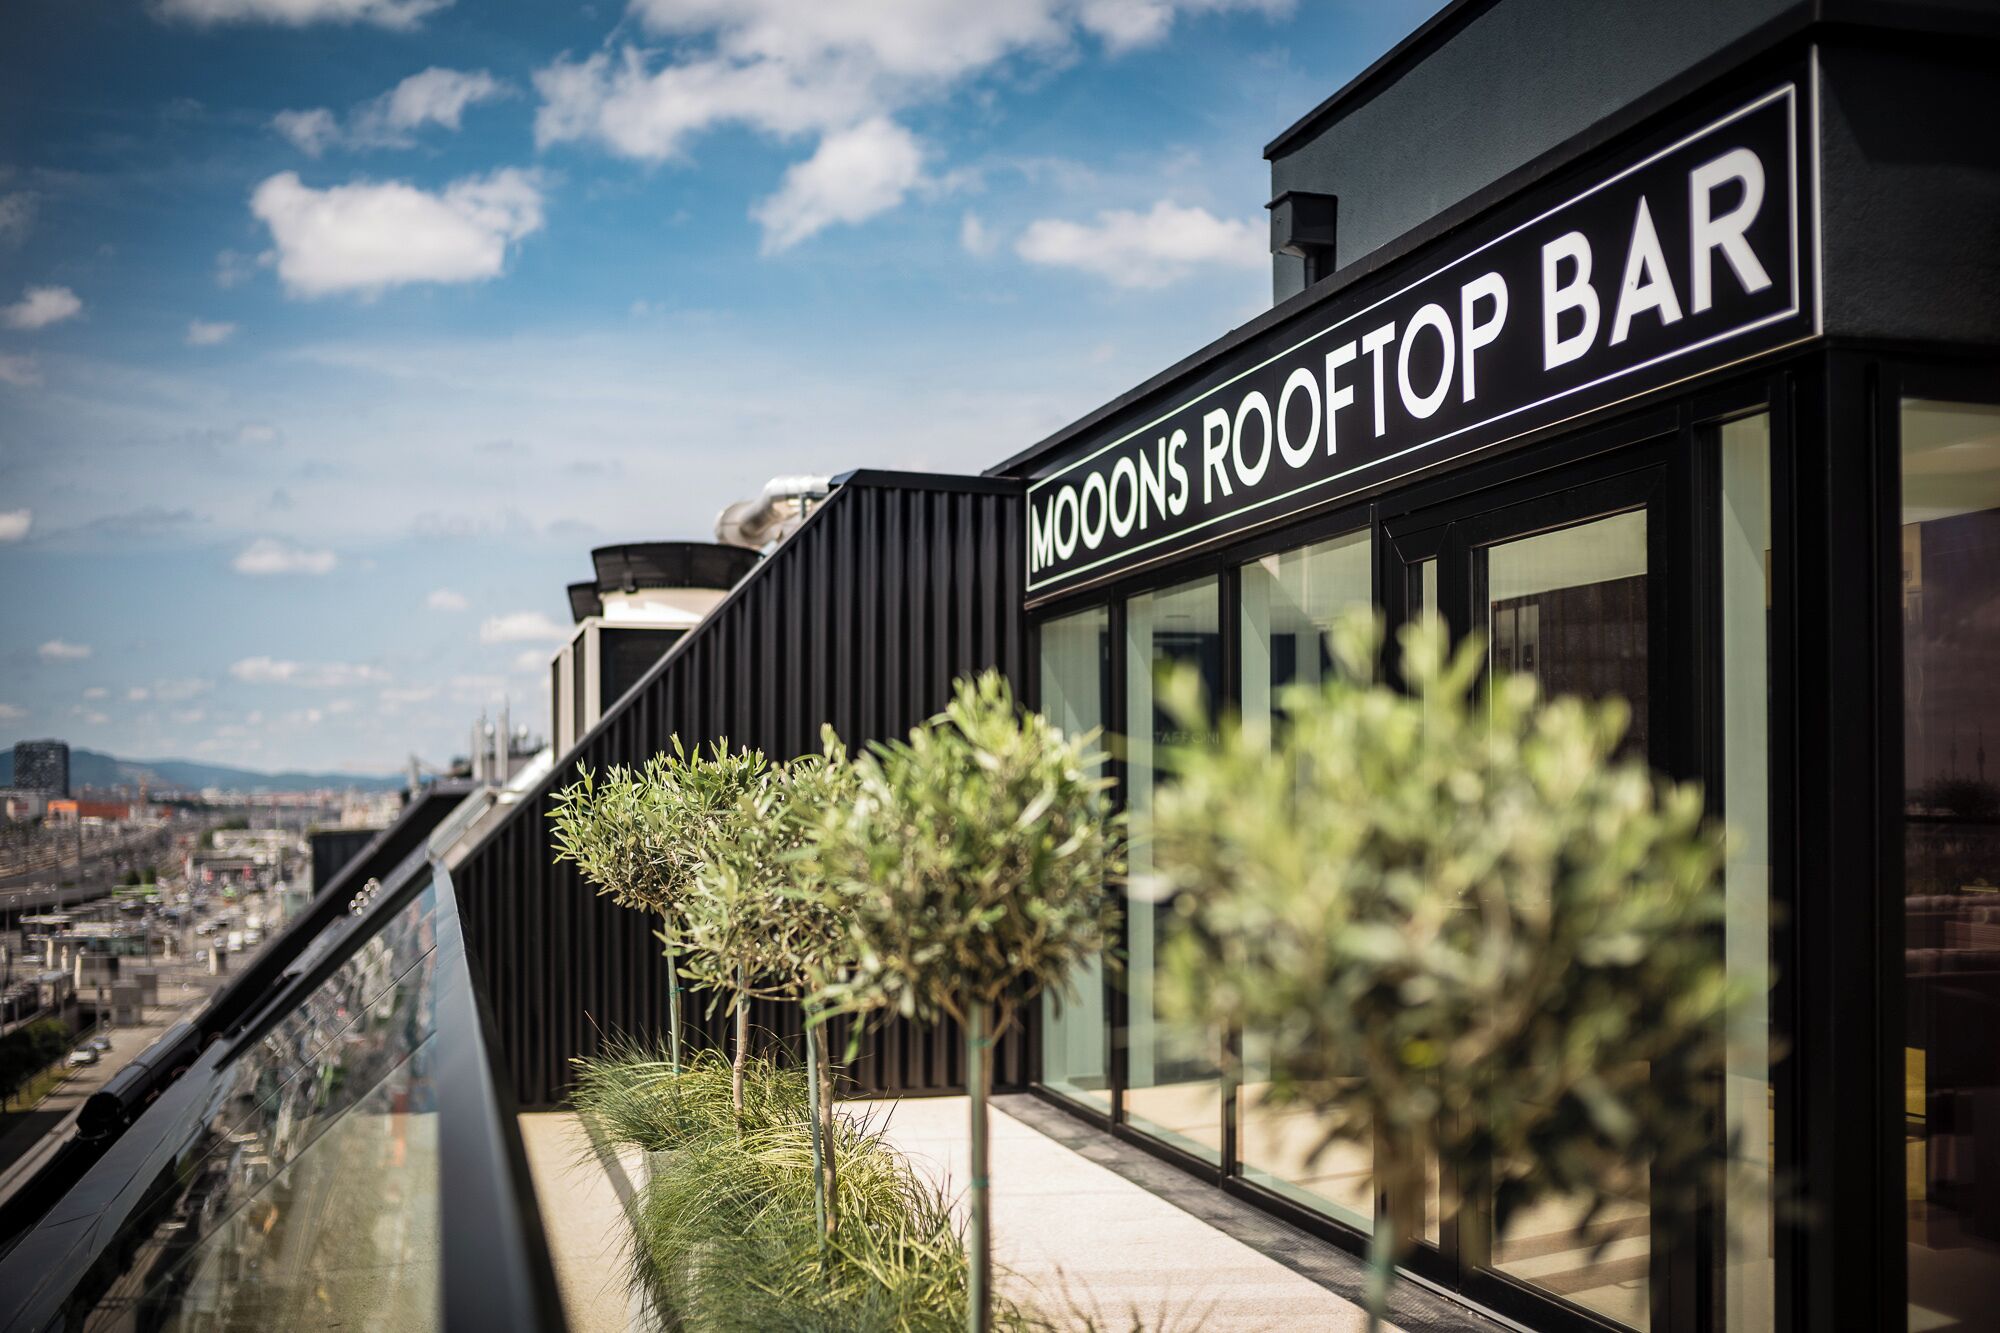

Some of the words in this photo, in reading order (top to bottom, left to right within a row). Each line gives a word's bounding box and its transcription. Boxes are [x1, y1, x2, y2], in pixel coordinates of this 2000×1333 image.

[1031, 428, 1189, 573] MOOONS
[1203, 271, 1509, 505] ROOFTOP
[1542, 149, 1772, 372] BAR
